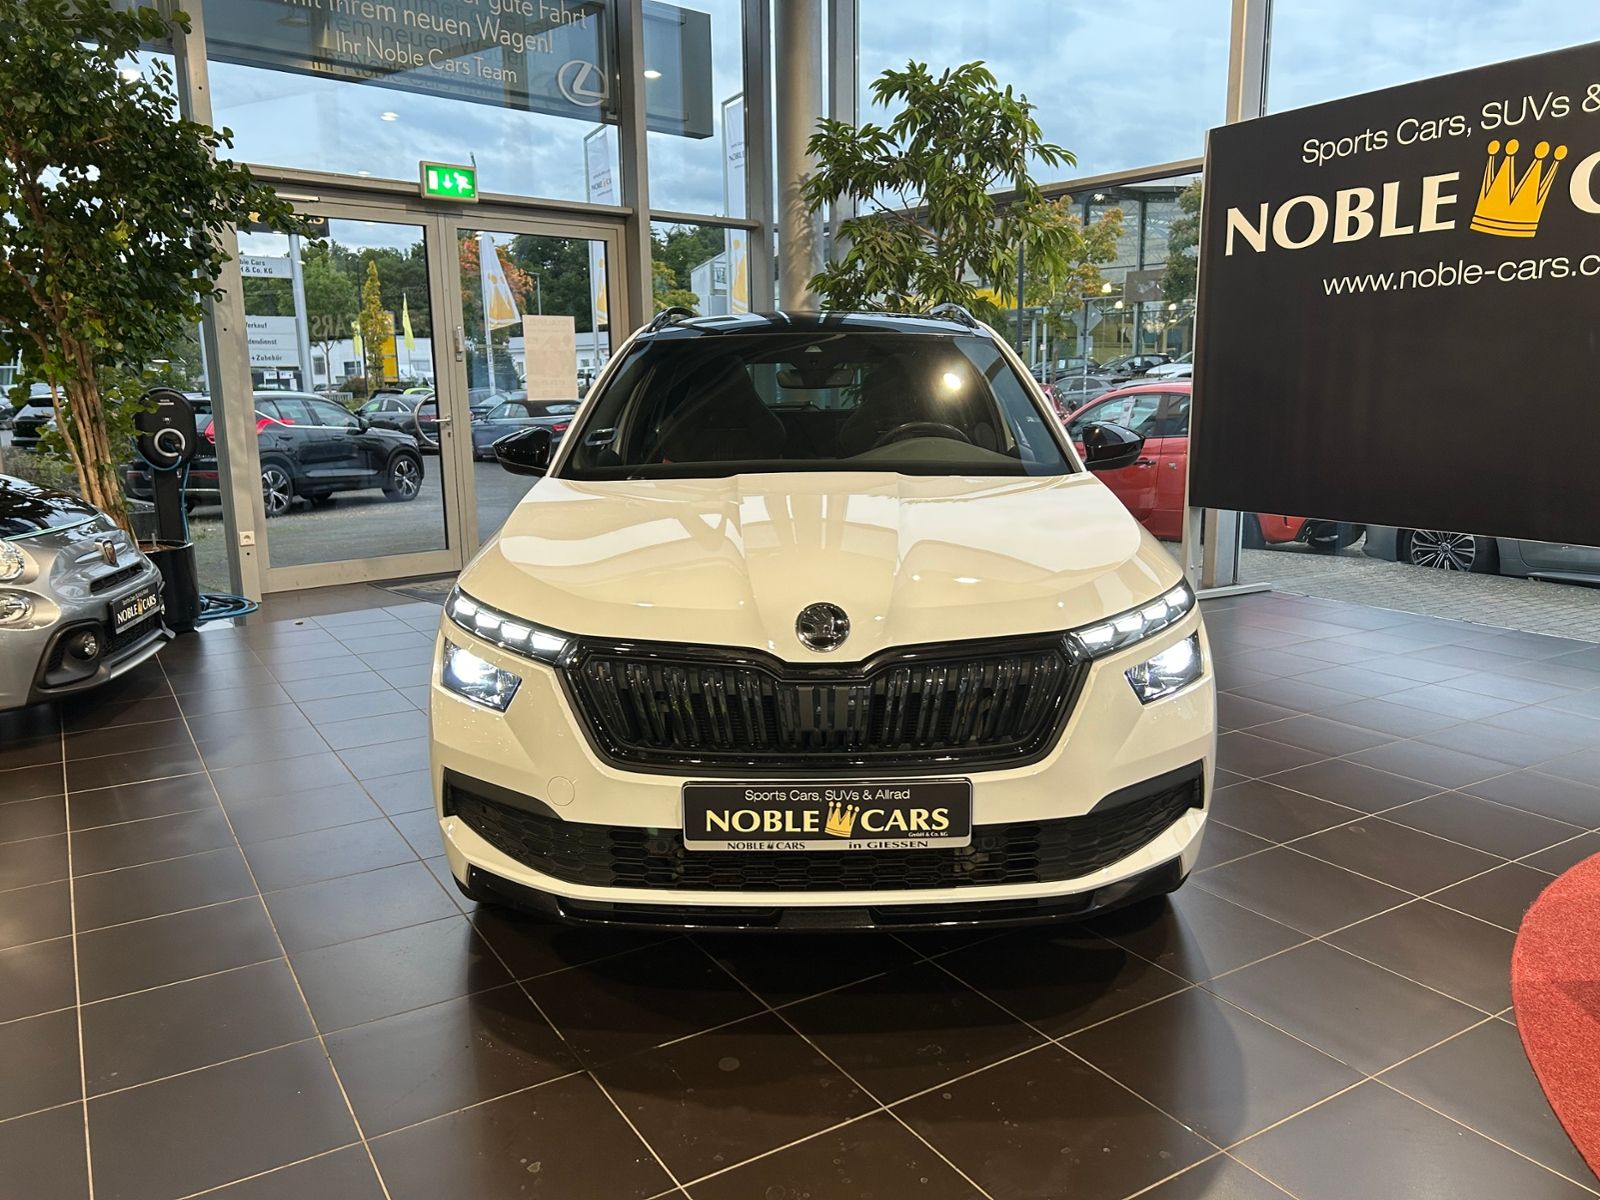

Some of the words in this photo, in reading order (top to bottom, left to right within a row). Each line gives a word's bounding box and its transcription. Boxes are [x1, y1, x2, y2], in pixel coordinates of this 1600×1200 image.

[539, 0, 587, 29] Fahrt
[403, 9, 471, 38] neuen
[475, 13, 554, 54] Wagen!
[335, 30, 362, 55] Ihr
[366, 36, 424, 66] Noble
[428, 48, 470, 75] Cars
[473, 56, 518, 83] Team
[1301, 126, 1389, 166] Sports
[1396, 111, 1473, 145] Cars,
[1479, 91, 1571, 131] SUVs
[1581, 83, 1600, 113] &
[1224, 171, 1461, 257] NOBLE
[117, 603, 138, 625] NOBLE
[744, 789, 787, 802] Sports
[789, 789, 822, 802] Cars,
[824, 789, 860, 801] SUVs
[862, 789, 873, 800] &
[875, 788, 911, 800] Allrad
[705, 809, 820, 833] NOBLE
[860, 807, 950, 832] CARS
[727, 842, 765, 850] NOBLE
[775, 841, 806, 850] CARS
[848, 841, 862, 849] in
[866, 840, 929, 849] GIESSEN
